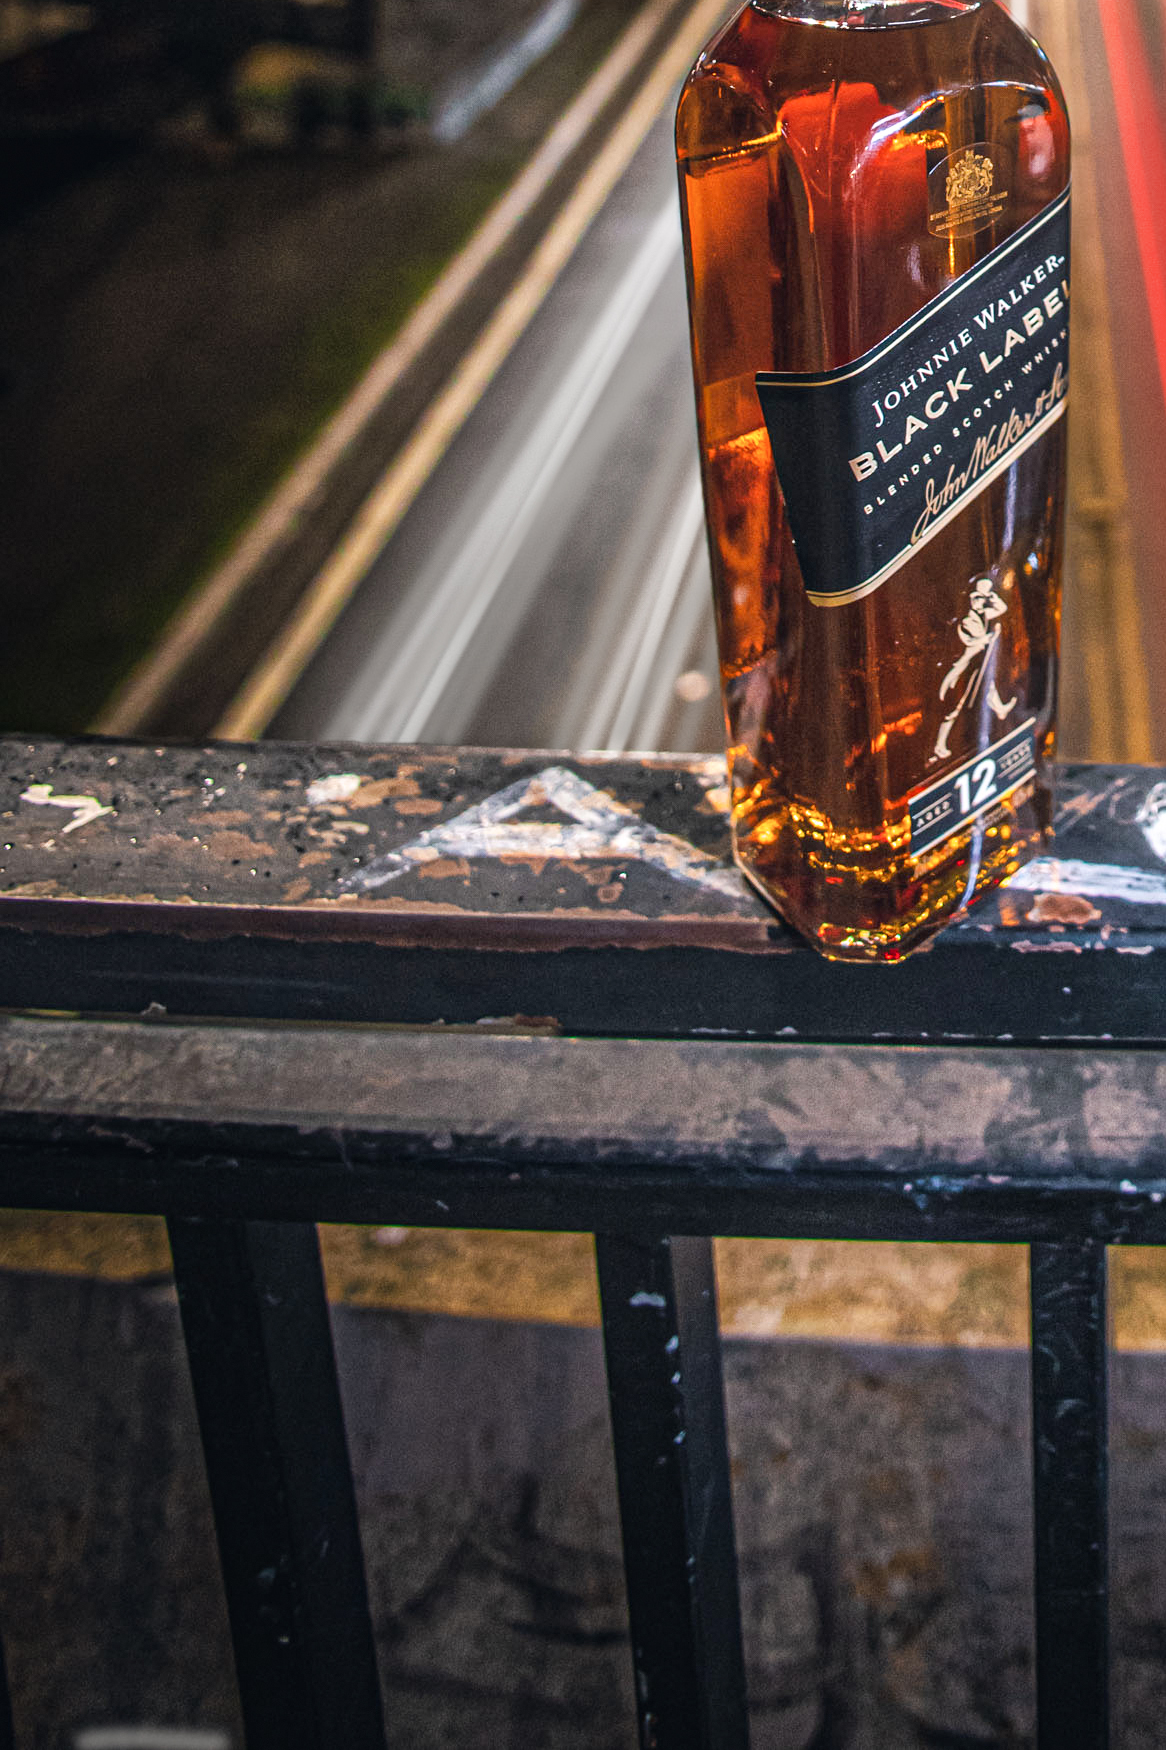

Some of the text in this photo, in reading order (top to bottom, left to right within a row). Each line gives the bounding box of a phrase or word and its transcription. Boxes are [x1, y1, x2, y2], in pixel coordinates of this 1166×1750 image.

[871, 254, 1060, 427] JOHNNIE WALKER
[848, 367, 974, 483] BLACK
[864, 443, 943, 515] BLENDED
[952, 378, 1014, 438] SCOTCH
[911, 464, 968, 544] John
[969, 408, 1034, 480] Walker
[953, 758, 998, 815] 12
